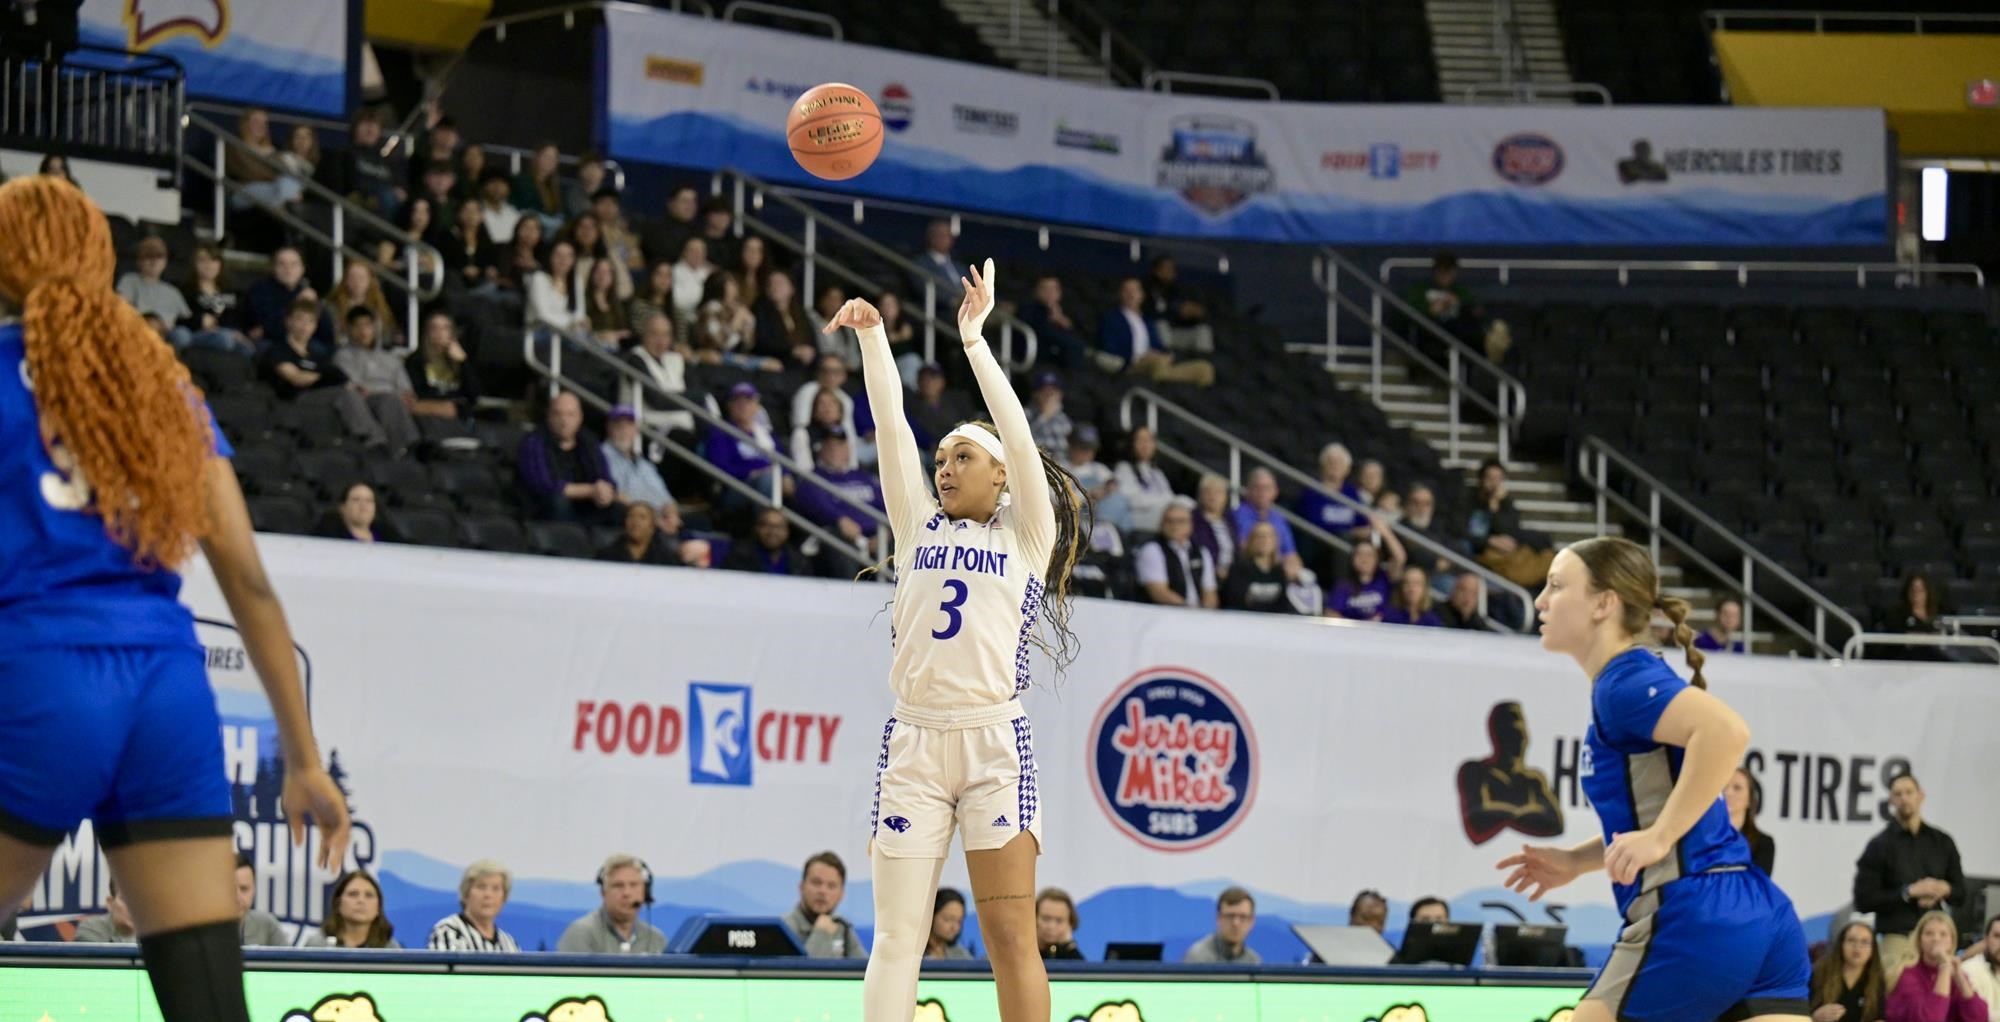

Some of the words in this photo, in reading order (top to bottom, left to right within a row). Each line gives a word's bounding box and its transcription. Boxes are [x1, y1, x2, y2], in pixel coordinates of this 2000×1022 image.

[1780, 149, 1842, 175] TIRES
[914, 545, 948, 570] HIGH
[951, 546, 1007, 577] POINT
[932, 579, 968, 640] 3
[206, 649, 244, 671] IRES
[574, 700, 682, 756] FOOD
[756, 710, 841, 763] CITY
[1117, 702, 1233, 769] Jersey
[1776, 752, 1913, 823] TIRES
[1148, 811, 1198, 835] SUBS
